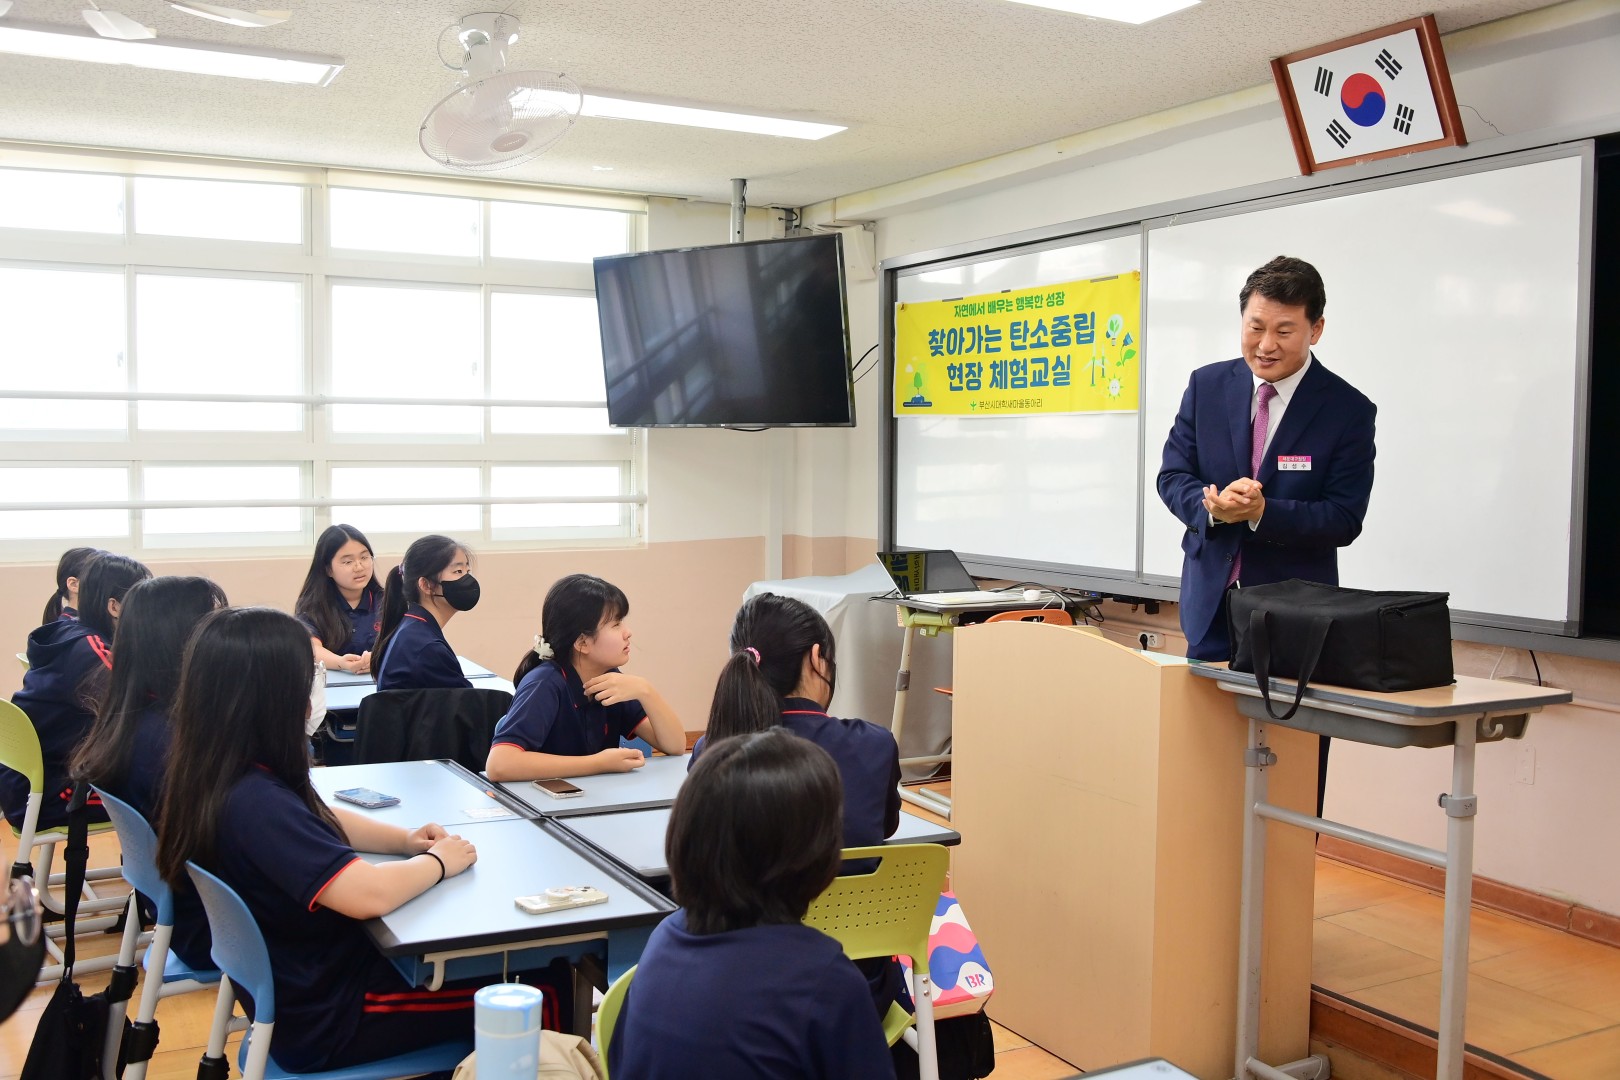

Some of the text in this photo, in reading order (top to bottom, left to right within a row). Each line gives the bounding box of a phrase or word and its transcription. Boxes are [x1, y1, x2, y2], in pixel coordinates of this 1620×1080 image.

[954, 291, 1066, 318] 자연에서 배우는 행복한 성장
[928, 311, 1096, 357] 찾아가는 탄소중립
[946, 354, 1072, 392] 현장 체험교실
[979, 398, 1043, 410] 부산시대학새마을동아리
[964, 973, 986, 988] BR
